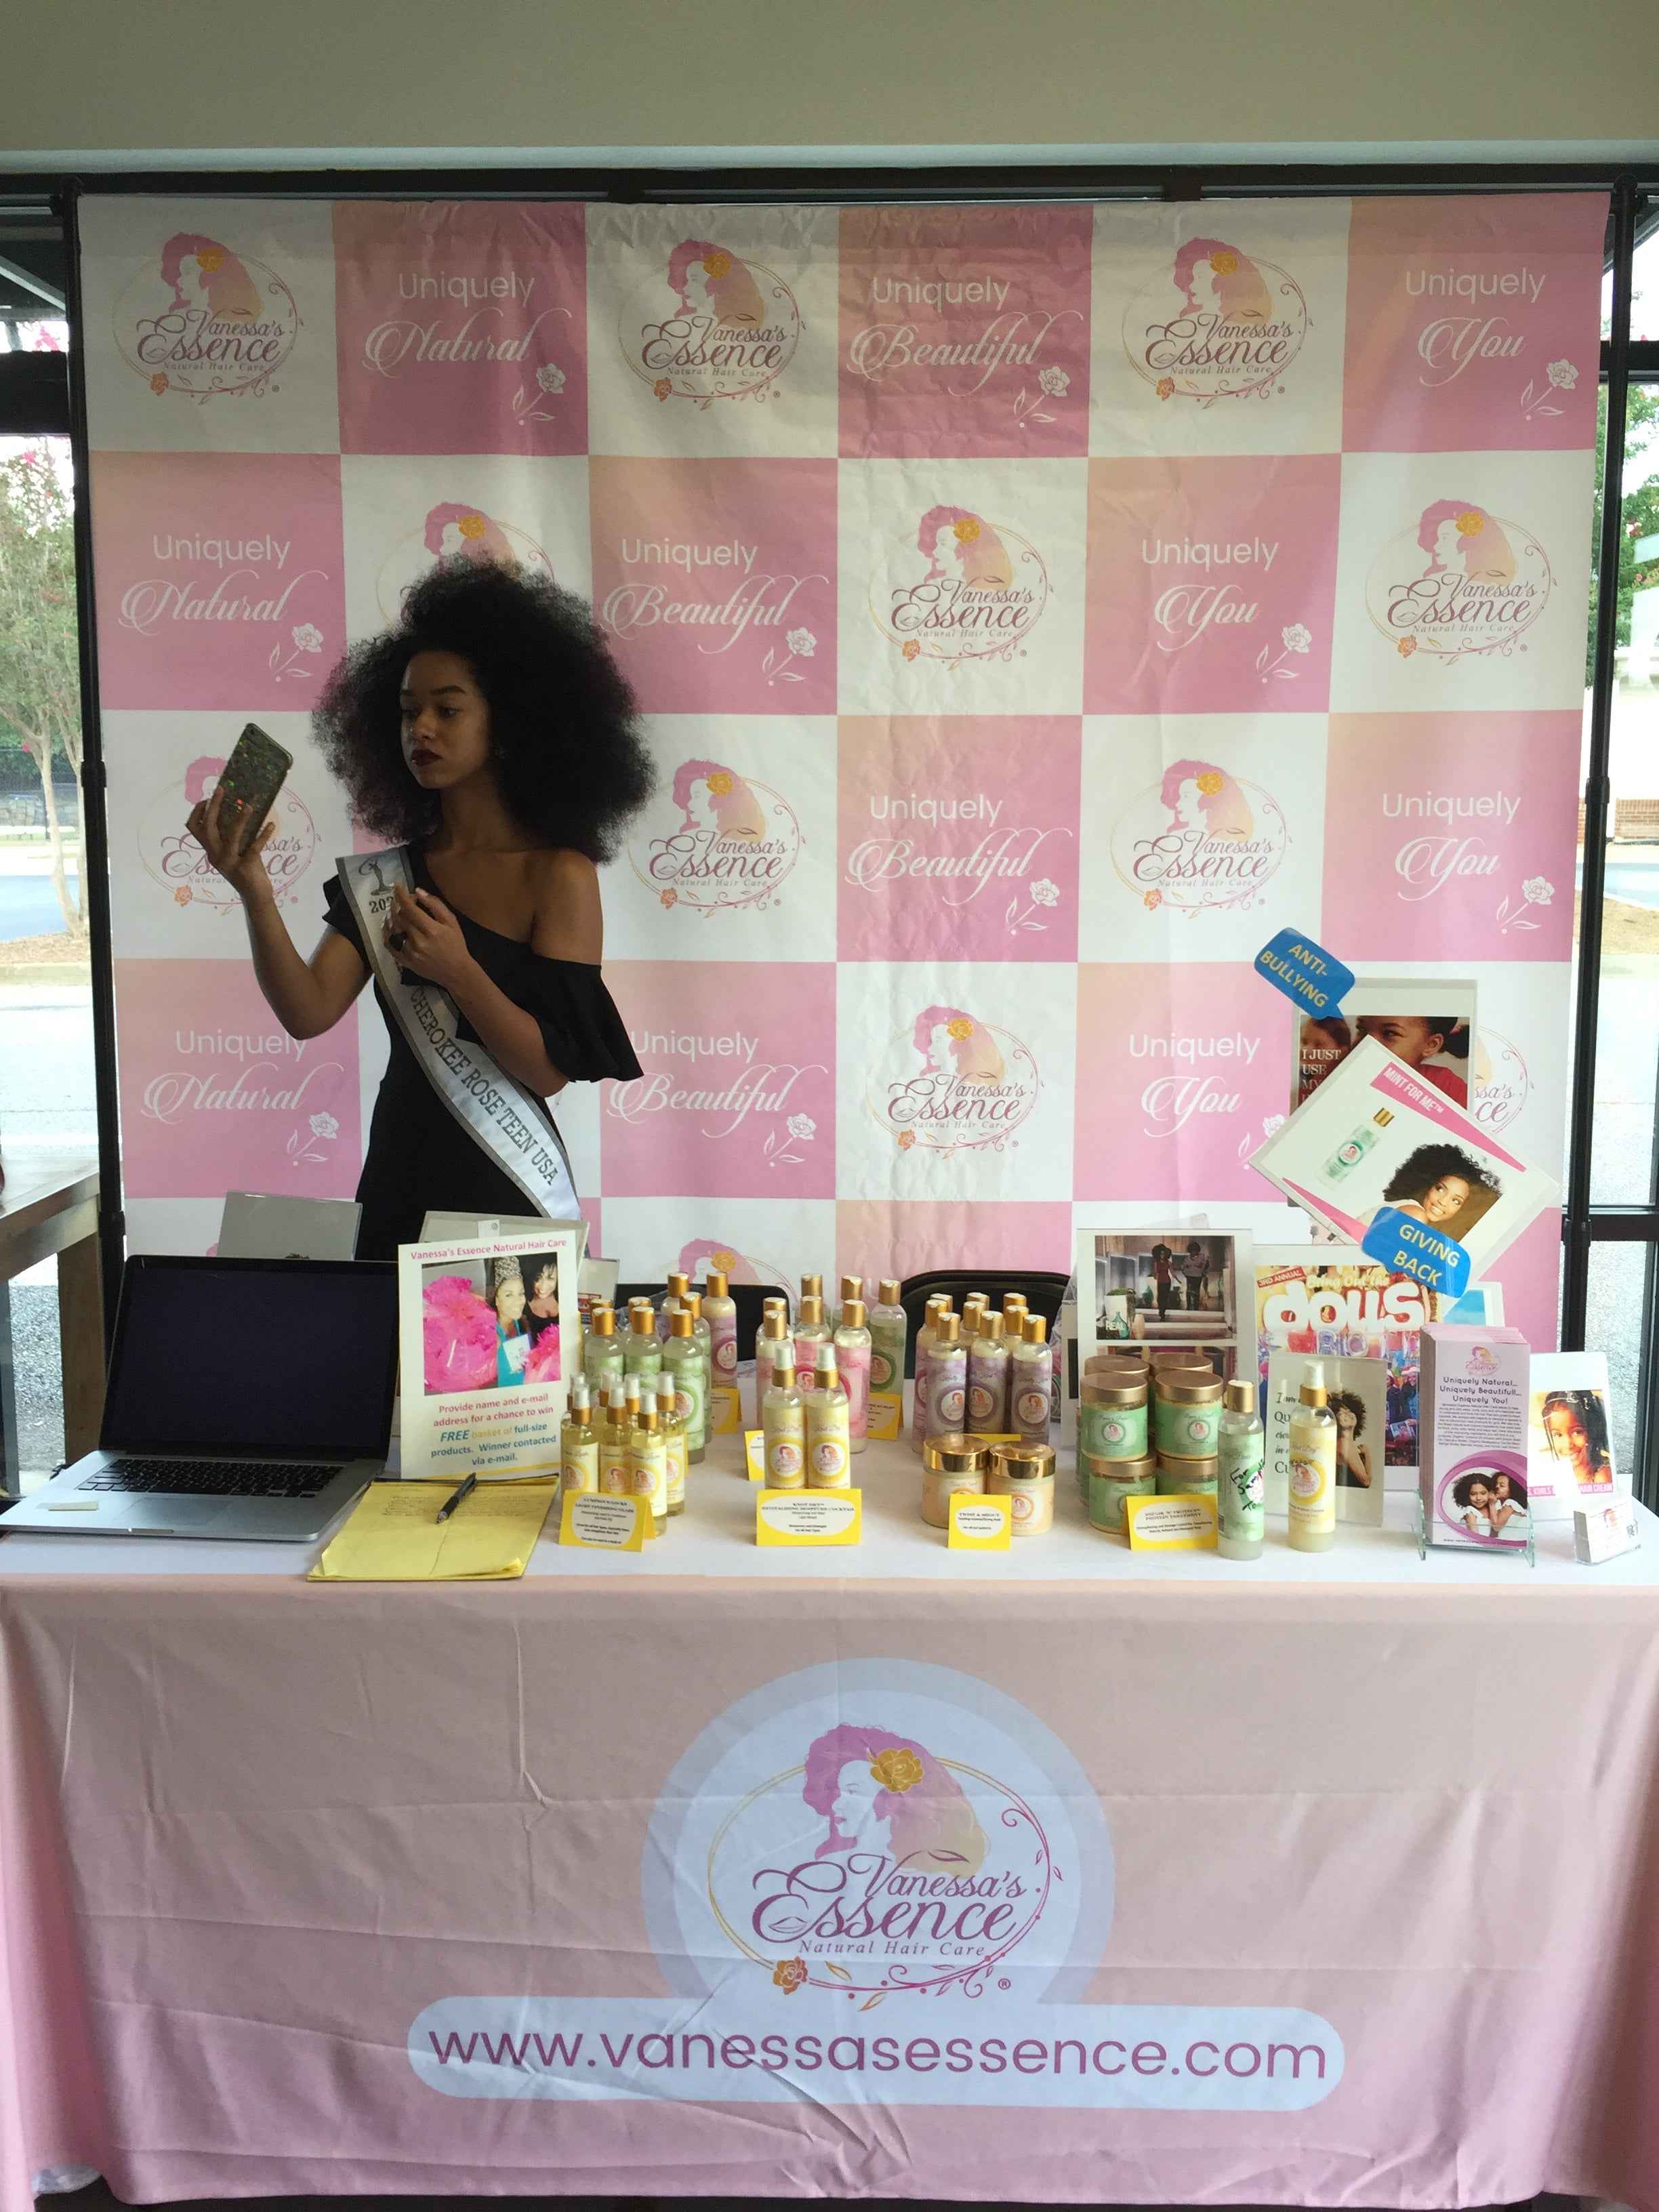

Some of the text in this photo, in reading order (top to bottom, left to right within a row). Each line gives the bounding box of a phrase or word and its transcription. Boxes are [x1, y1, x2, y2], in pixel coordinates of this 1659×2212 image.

[399, 271, 535, 307] Uniquely
[873, 276, 1009, 310] Uniquely
[1406, 267, 1545, 304] Uniquely
[137, 314, 281, 365] Essence
[186, 309, 284, 337] Vanessa's
[692, 316, 787, 343] Vanessa's
[1197, 312, 1292, 339] Vanessa's
[361, 308, 572, 378] Natural
[642, 320, 783, 370] Essence
[846, 310, 1084, 396] Beautiful
[1146, 319, 1288, 370] Essence
[1418, 316, 1526, 387] You
[152, 534, 291, 570] Uniquely
[621, 538, 758, 574] Uniquely
[1141, 537, 1279, 572] Uniquely
[117, 570, 329, 636] Natural
[941, 579, 1034, 605] Vanessa's
[1438, 573, 1536, 598] Vanessa's
[600, 575, 830, 655] Beautiful
[892, 583, 1029, 632] Essence
[1154, 583, 1259, 652] You
[1388, 579, 1532, 628] Essence
[869, 793, 1002, 827] Uniquely
[1382, 791, 1521, 825] Uniquely
[649, 834, 783, 882] Essence
[696, 830, 787, 855] Vanessa's
[1133, 834, 1270, 882] Essence
[1183, 830, 1274, 855] Vanessa's
[844, 827, 1073, 906] Beautiful
[1395, 836, 1502, 901] You
[1288, 943, 1328, 977] ANTI-
[1259, 949, 1329, 1007] BULLYING
[176, 1028, 308, 1063] Uniquely
[632, 1029, 759, 1063] Uniquely
[1129, 1031, 1260, 1065] Uniquely
[1303, 1049, 1341, 1060] I JUST
[411, 987, 558, 1185] CHEROKEE ROSE TEEN USA
[935, 1073, 1026, 1099] Vanessa's
[1302, 1064, 1326, 1075] USE
[1382, 1067, 1406, 1089] MINT
[1404, 1080, 1425, 1101] FOR
[140, 1062, 344, 1125] Natural
[607, 1064, 829, 1139] Beautiful
[888, 1078, 1022, 1123] Essence
[1140, 1075, 1243, 1138] You
[411, 1239, 567, 1261] Vanessa's Essence Natural Hair Care
[1398, 1223, 1460, 1268] GIVING
[1258, 1277, 1273, 1286] 3RD
[1273, 1269, 1302, 1282] ANNUAL
[1393, 1250, 1443, 1286] BACK
[1439, 1386, 1475, 1394] Uniquely
[1443, 1377, 1479, 1386] Uniquely
[433, 1416, 469, 1427] address
[471, 1414, 485, 1423] for
[494, 1410, 524, 1420] chance
[527, 1409, 536, 1417] to
[538, 1406, 554, 1415] win
[438, 1393, 548, 1413] Provide name and e-mail
[1453, 1395, 1488, 1404] Uniquely
[431, 1435, 557, 1457] products. Winner contacted
[440, 1429, 470, 1442] FREE
[514, 1422, 548, 1433] full-size
[472, 1452, 518, 1465] via e-mail.
[847, 1849, 1027, 1899] Vanessa's
[752, 1861, 1017, 1944] Essence
[799, 1939, 985, 1957] Natural Hair Care
[428, 2028, 1327, 2080] www.vanessasessence.com
